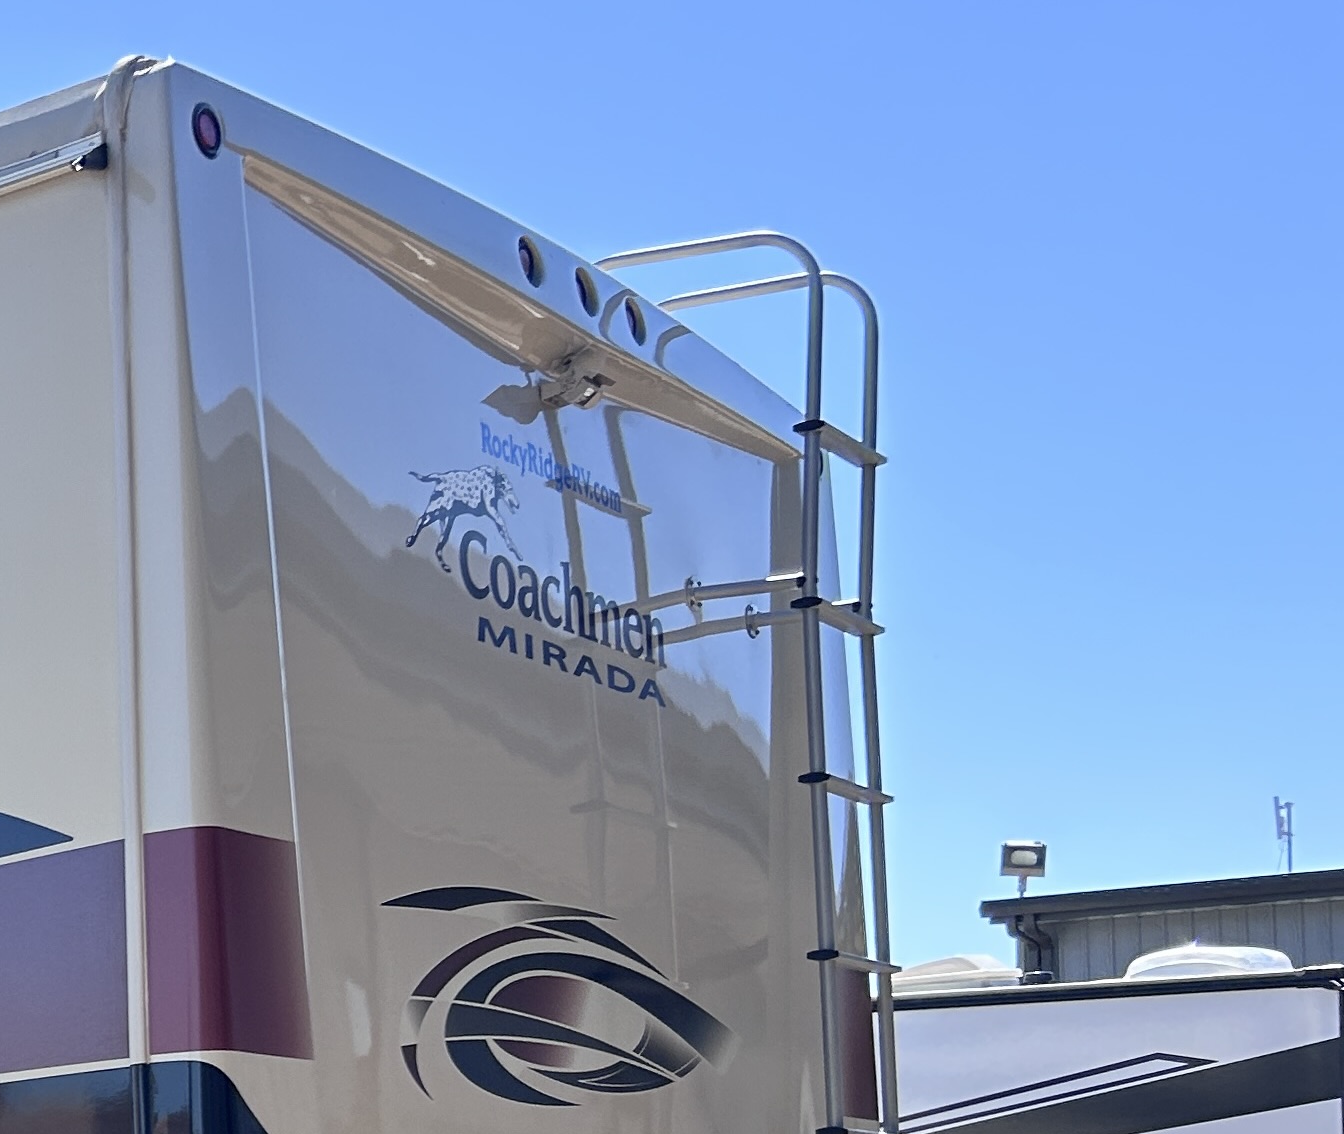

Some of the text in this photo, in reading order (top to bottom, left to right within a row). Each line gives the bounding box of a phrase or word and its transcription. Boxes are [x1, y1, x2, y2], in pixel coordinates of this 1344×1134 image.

[480, 422, 622, 513] RockyRidgeRV.com
[459, 530, 667, 669] Coachmen
[477, 616, 666, 707] MIRADA
